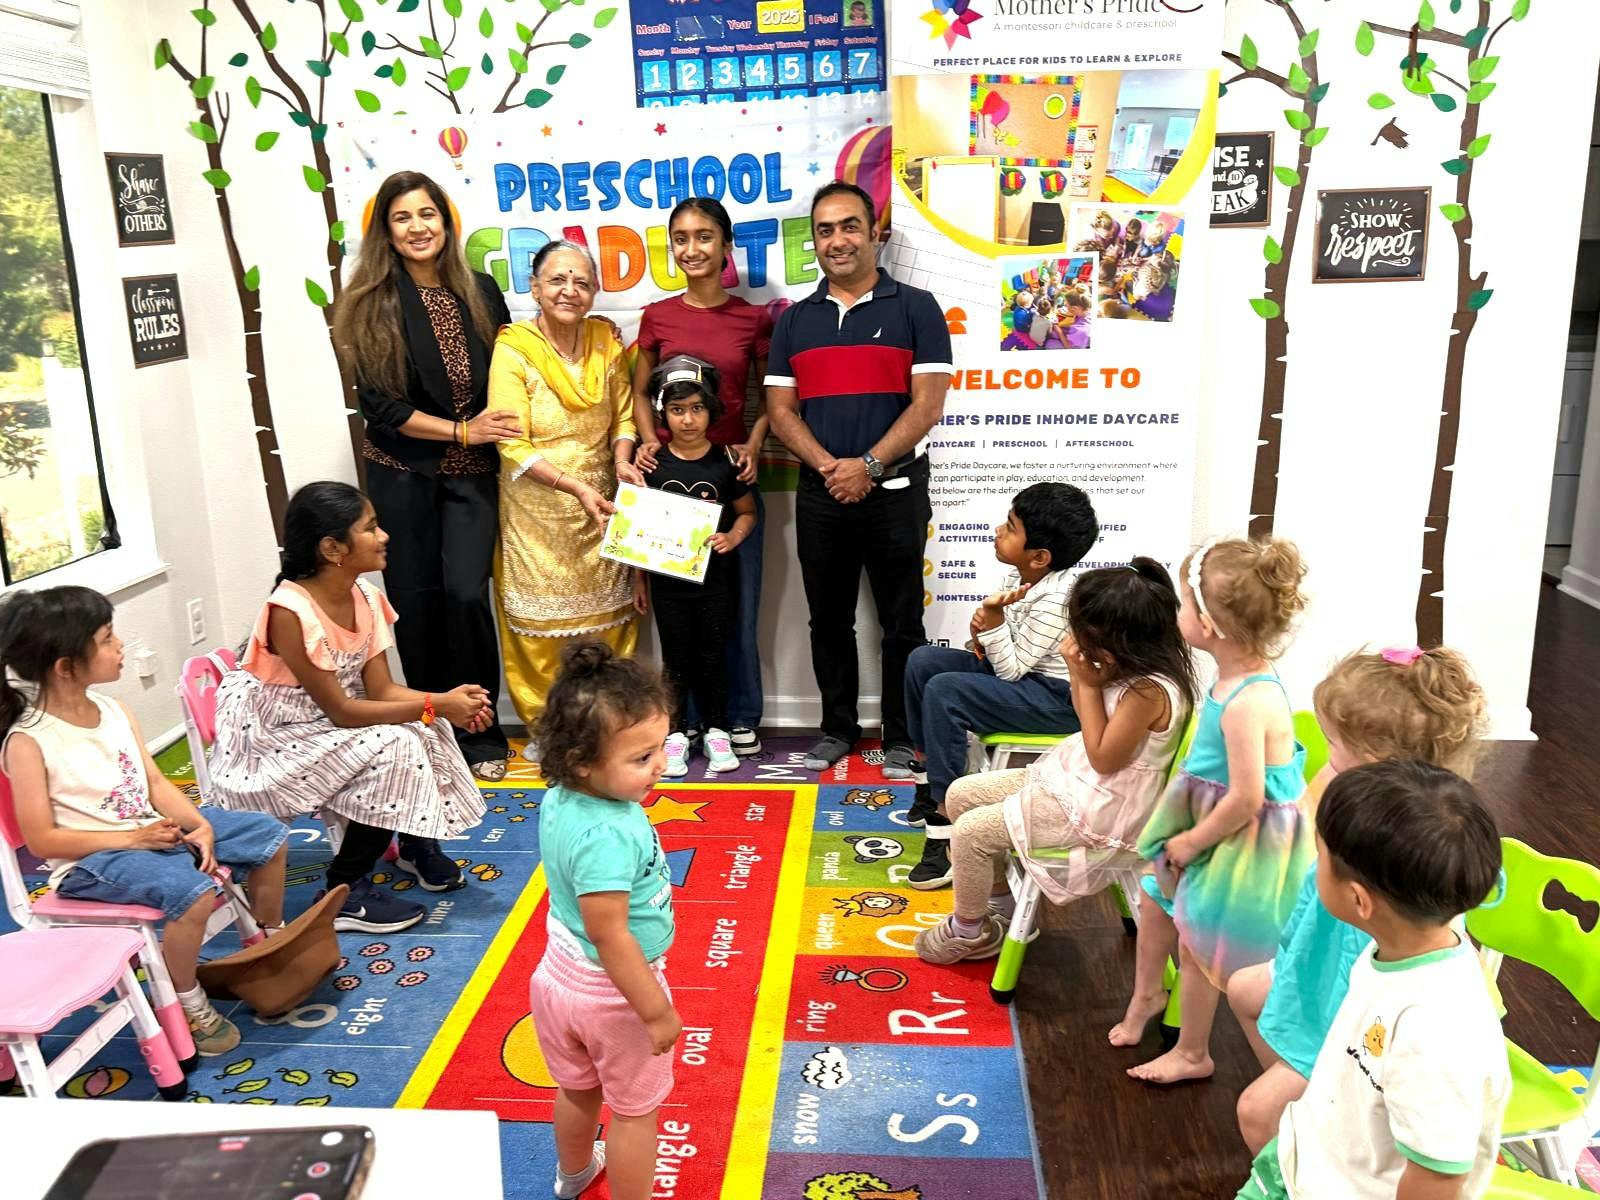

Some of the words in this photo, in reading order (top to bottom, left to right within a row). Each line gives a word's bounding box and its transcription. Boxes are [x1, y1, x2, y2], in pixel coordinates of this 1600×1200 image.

[636, 24, 671, 35] Month
[726, 19, 752, 30] Year
[762, 10, 800, 25] 2025
[814, 13, 839, 24] Feel
[1004, 22, 1062, 31] montessori
[1065, 20, 1113, 30] childcare
[1115, 20, 1122, 29] &
[1126, 19, 1177, 29] preschool
[638, 48, 665, 56] Sunday
[814, 38, 839, 47] Friday
[933, 58, 979, 66] PERFECT
[982, 57, 1016, 66] PLACE
[1019, 56, 1039, 64] FOR
[1042, 56, 1066, 64] KIDS
[1070, 56, 1083, 64] TO
[1086, 55, 1120, 64] LEARN
[1124, 54, 1130, 62] &
[1134, 53, 1182, 62] EXPLORE
[650, 64, 662, 88] 1
[681, 62, 698, 86] 2
[718, 61, 733, 85] 3
[751, 58, 767, 82] 4
[784, 57, 800, 80] 5
[820, 54, 834, 77] 6
[854, 52, 870, 75] 7
[494, 152, 792, 213] PRESCHOOL
[1212, 189, 1250, 212] EAK
[125, 213, 167, 233] OTHERS
[1350, 212, 1403, 229] SHOW
[466, 216, 819, 294] GRADUTE
[1325, 224, 1421, 274] respect
[134, 314, 180, 342] RULES
[1100, 368, 1141, 388] TO
[936, 414, 980, 426] HER'S
[985, 414, 1032, 426] PRIDE
[1036, 414, 1098, 425] INHOME
[1103, 414, 1180, 424] DAYCARE
[930, 461, 948, 470] her's
[950, 462, 971, 470] Pride
[973, 462, 1008, 470] Daycare,
[1056, 462, 1096, 470] nurturing
[942, 486, 966, 494] below
[983, 486, 996, 494] the
[998, 486, 1024, 494] defini
[950, 474, 996, 484] participate
[1006, 474, 1026, 483] play,
[746, 803, 767, 822] star
[821, 810, 844, 826] owl
[482, 828, 506, 842] ten
[724, 844, 762, 889] triangle
[822, 850, 848, 880] panda
[424, 900, 454, 925] nine
[706, 918, 742, 968] square
[815, 913, 845, 950] queen
[340, 998, 388, 1036] eight
[797, 1000, 836, 1033] ring
[682, 1026, 713, 1066] oval
[793, 1092, 820, 1145] snow
